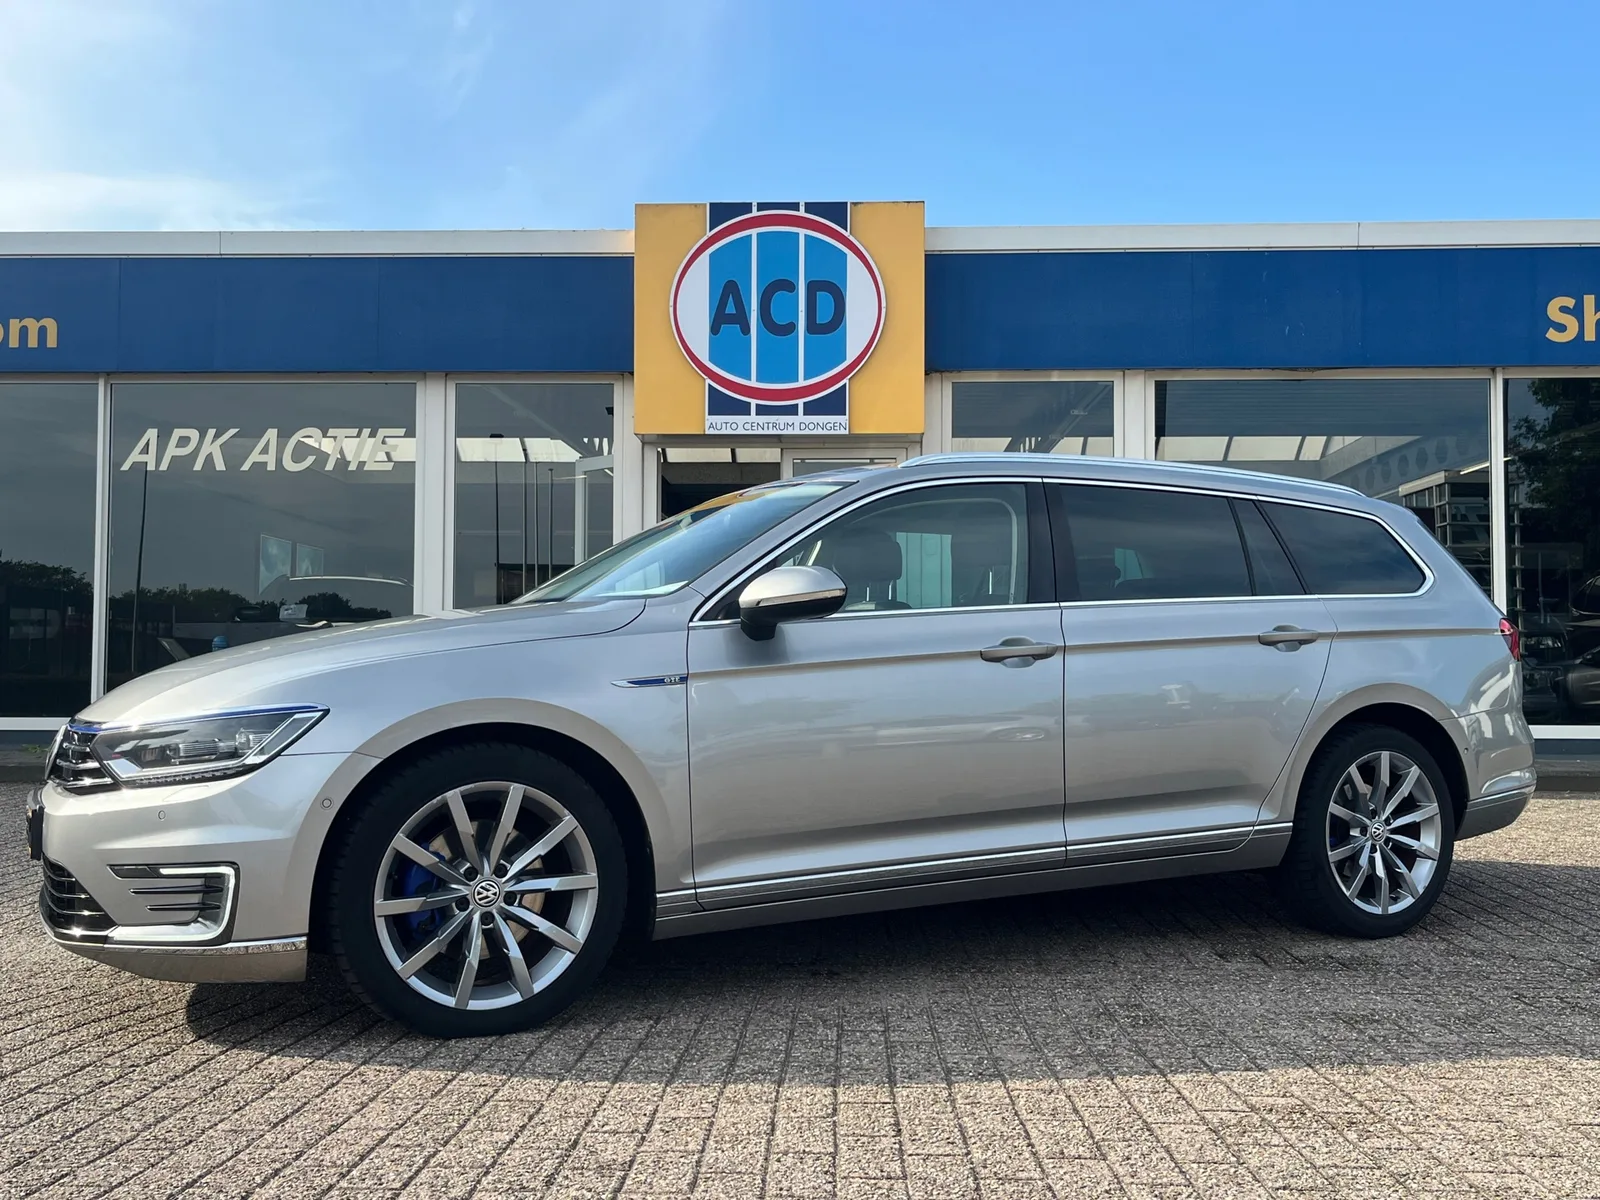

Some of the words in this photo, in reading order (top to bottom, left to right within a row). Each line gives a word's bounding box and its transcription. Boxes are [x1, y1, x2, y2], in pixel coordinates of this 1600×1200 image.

[710, 278, 846, 337] ACD
[0, 317, 58, 348] m
[707, 421, 739, 431] AUTO
[742, 421, 795, 431] CENTRUM
[799, 421, 847, 431] DONGEN
[120, 427, 241, 471] APK
[240, 427, 407, 472] ACTIE
